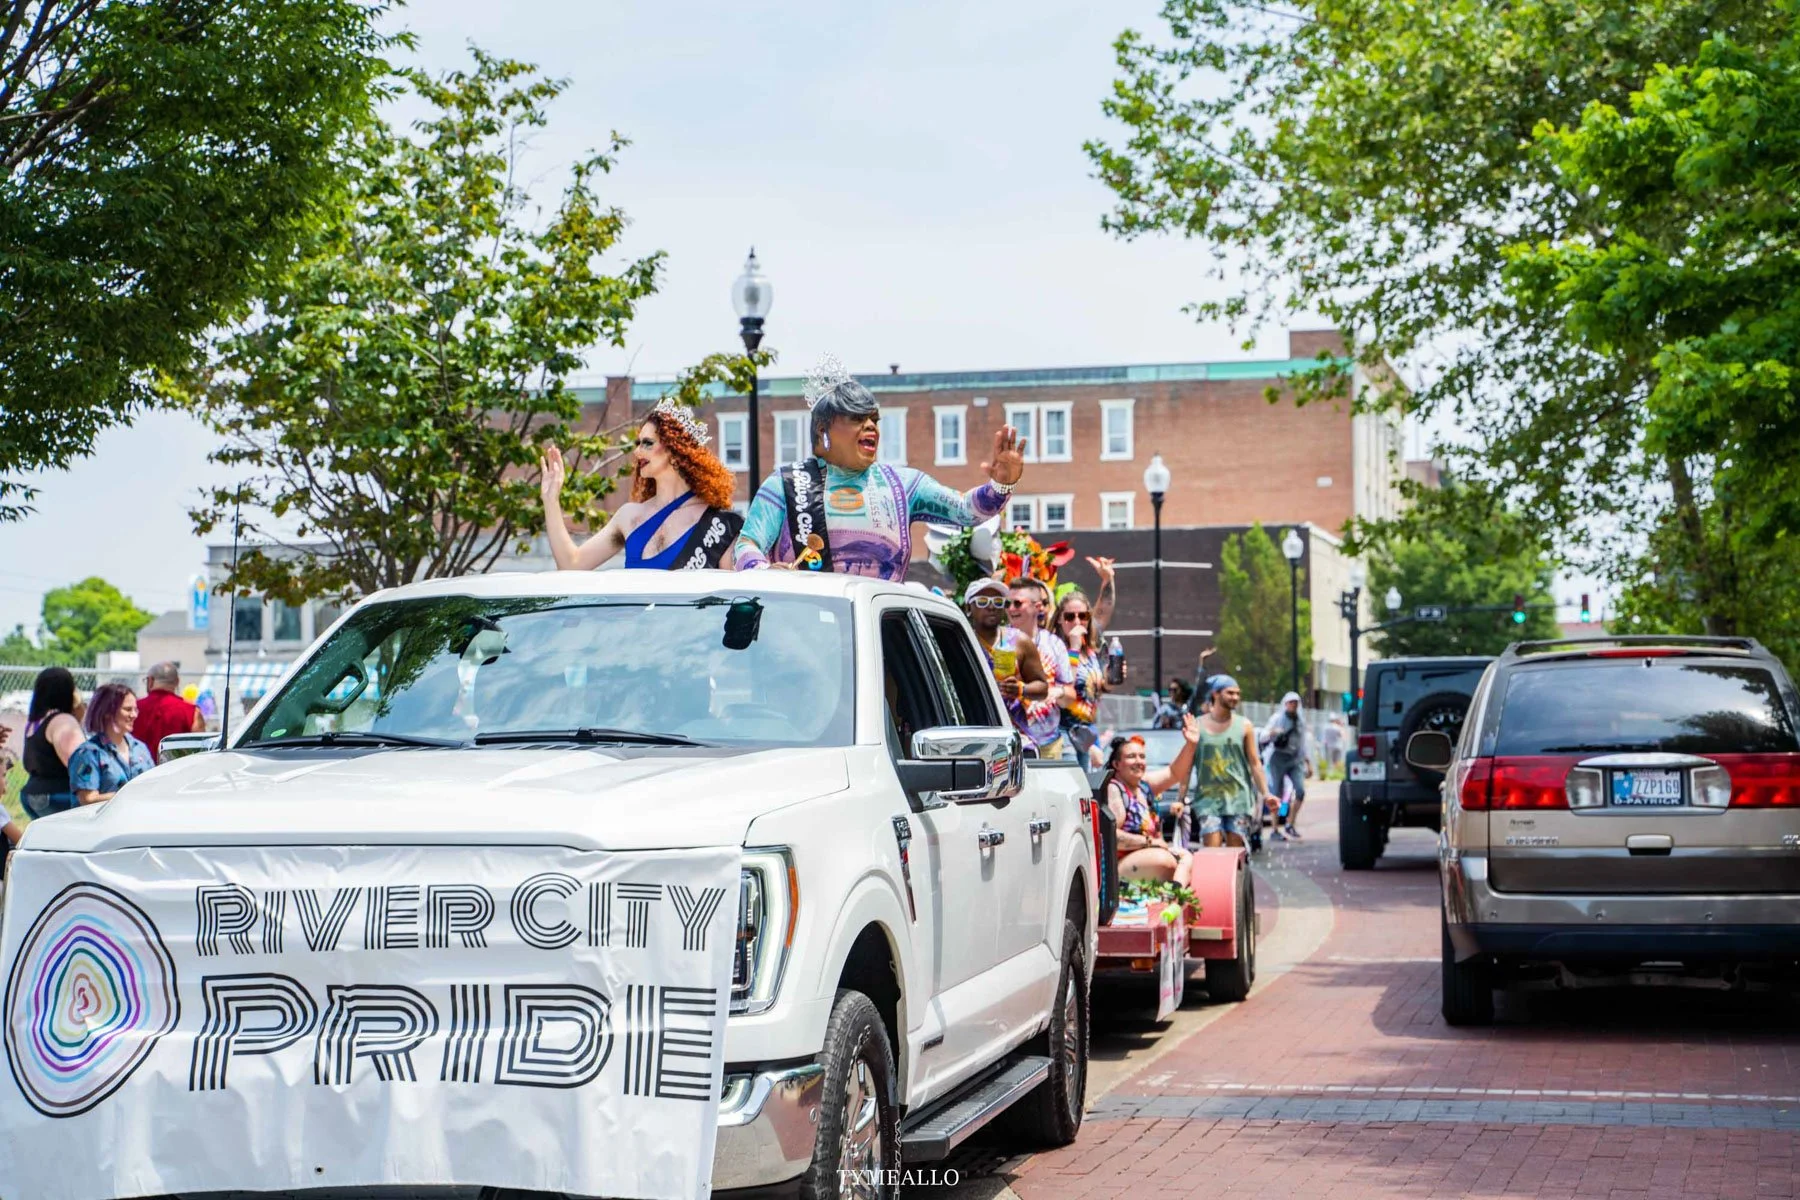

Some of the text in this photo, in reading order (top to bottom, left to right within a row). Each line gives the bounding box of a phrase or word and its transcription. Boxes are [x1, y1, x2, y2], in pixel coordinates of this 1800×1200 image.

[793, 468, 811, 512] River
[796, 512, 813, 547] City
[1634, 780, 1680, 795] ZZP169
[196, 872, 727, 957] RIVER CITY
[189, 972, 717, 1101] PRIDE
